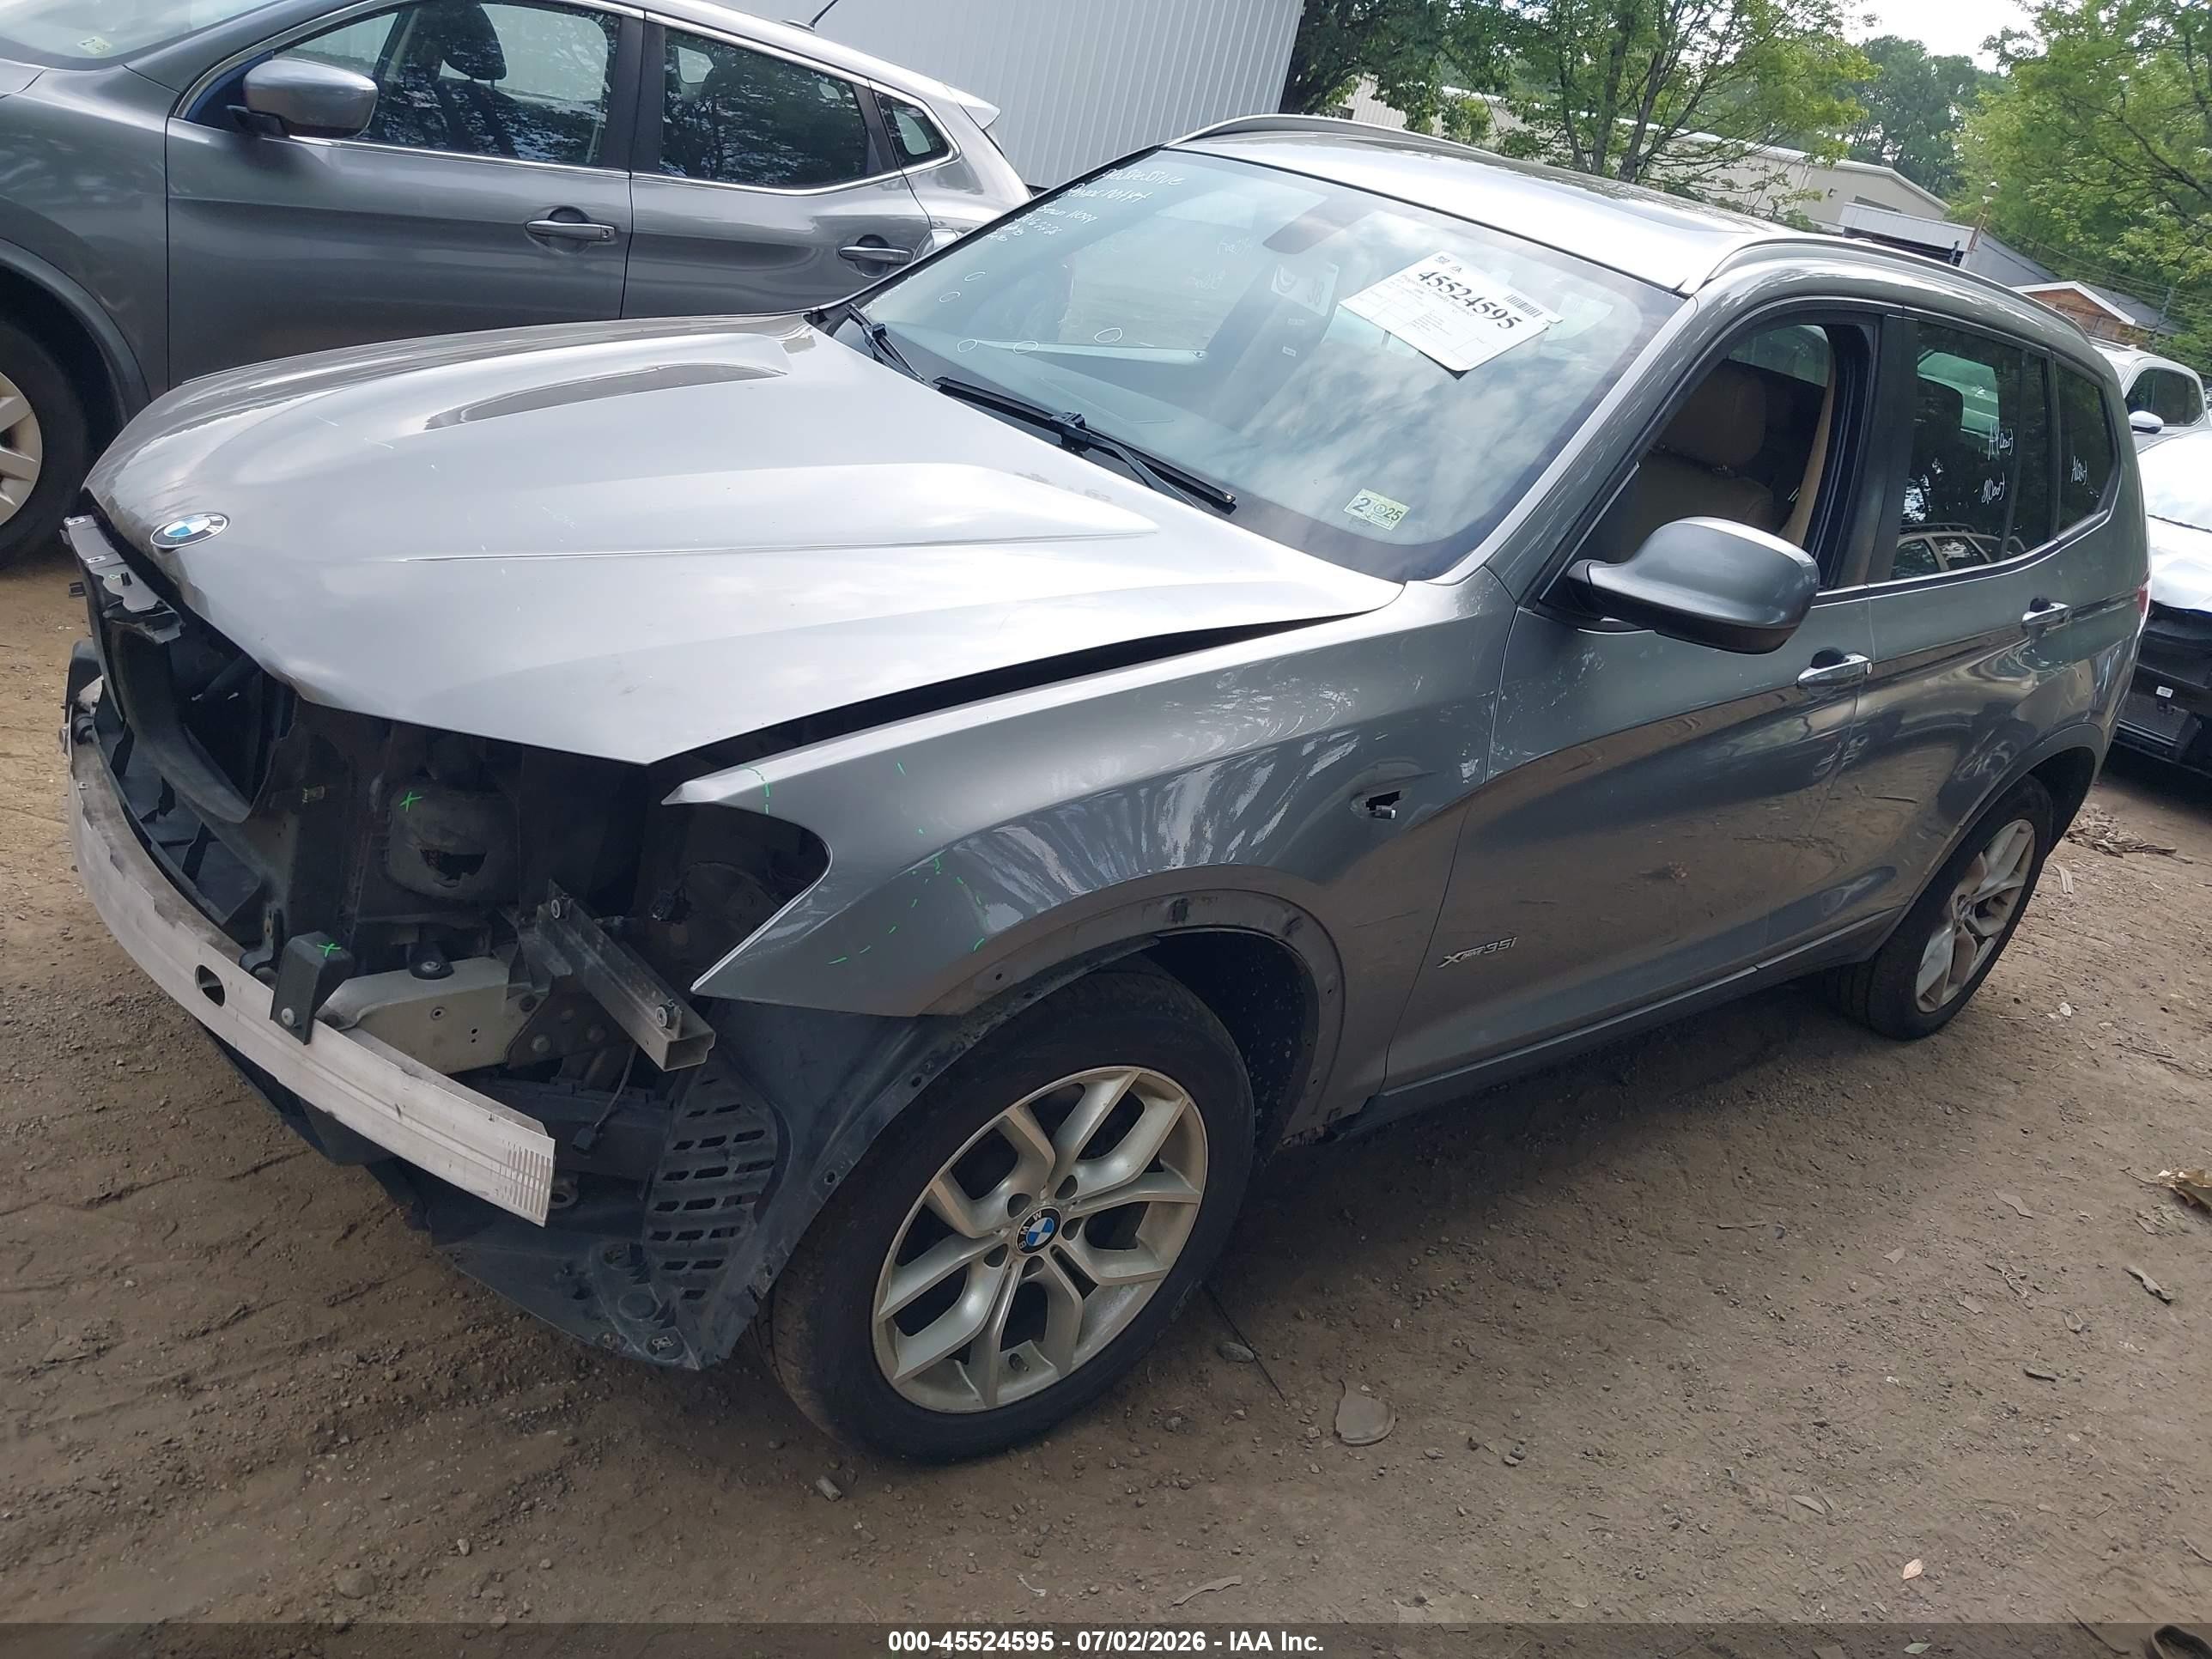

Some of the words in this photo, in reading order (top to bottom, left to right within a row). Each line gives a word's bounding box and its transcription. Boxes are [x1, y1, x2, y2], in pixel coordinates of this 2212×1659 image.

[1418, 270, 1524, 331] 45524595
[1353, 497, 1371, 513] 2
[1383, 507, 1403, 521] 25
[1018, 1211, 1042, 1249] BMW
